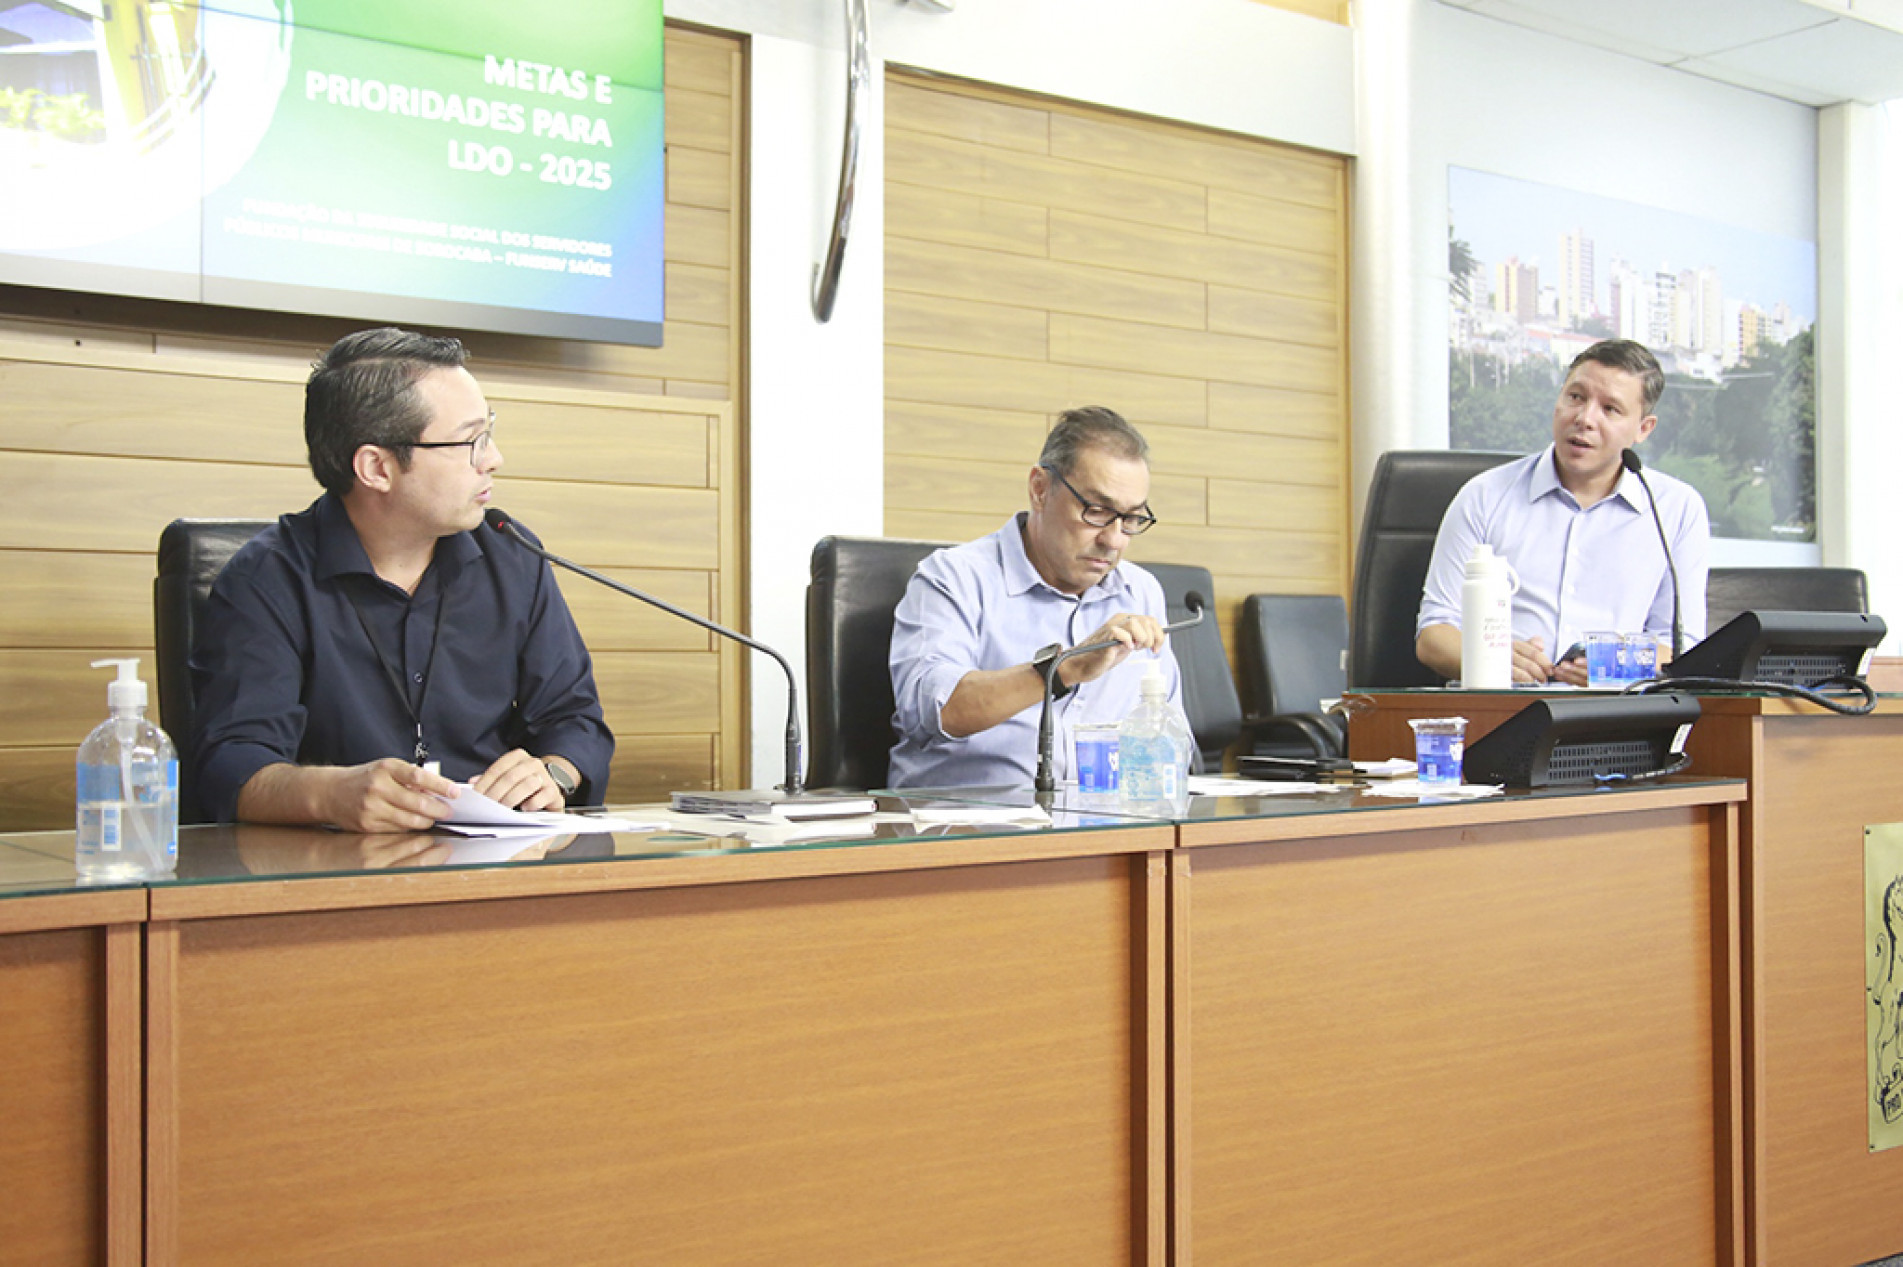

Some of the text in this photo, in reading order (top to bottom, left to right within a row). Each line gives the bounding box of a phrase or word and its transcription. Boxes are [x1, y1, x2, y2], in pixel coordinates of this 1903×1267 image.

[484, 54, 613, 105] METAS E
[305, 70, 613, 148] PRIORIDADES PARA
[448, 139, 513, 176] LDO
[539, 153, 613, 191] 2025
[450, 224, 499, 244] SOCIAL
[501, 230, 530, 247] DOS
[567, 258, 613, 278] SAÚDE
